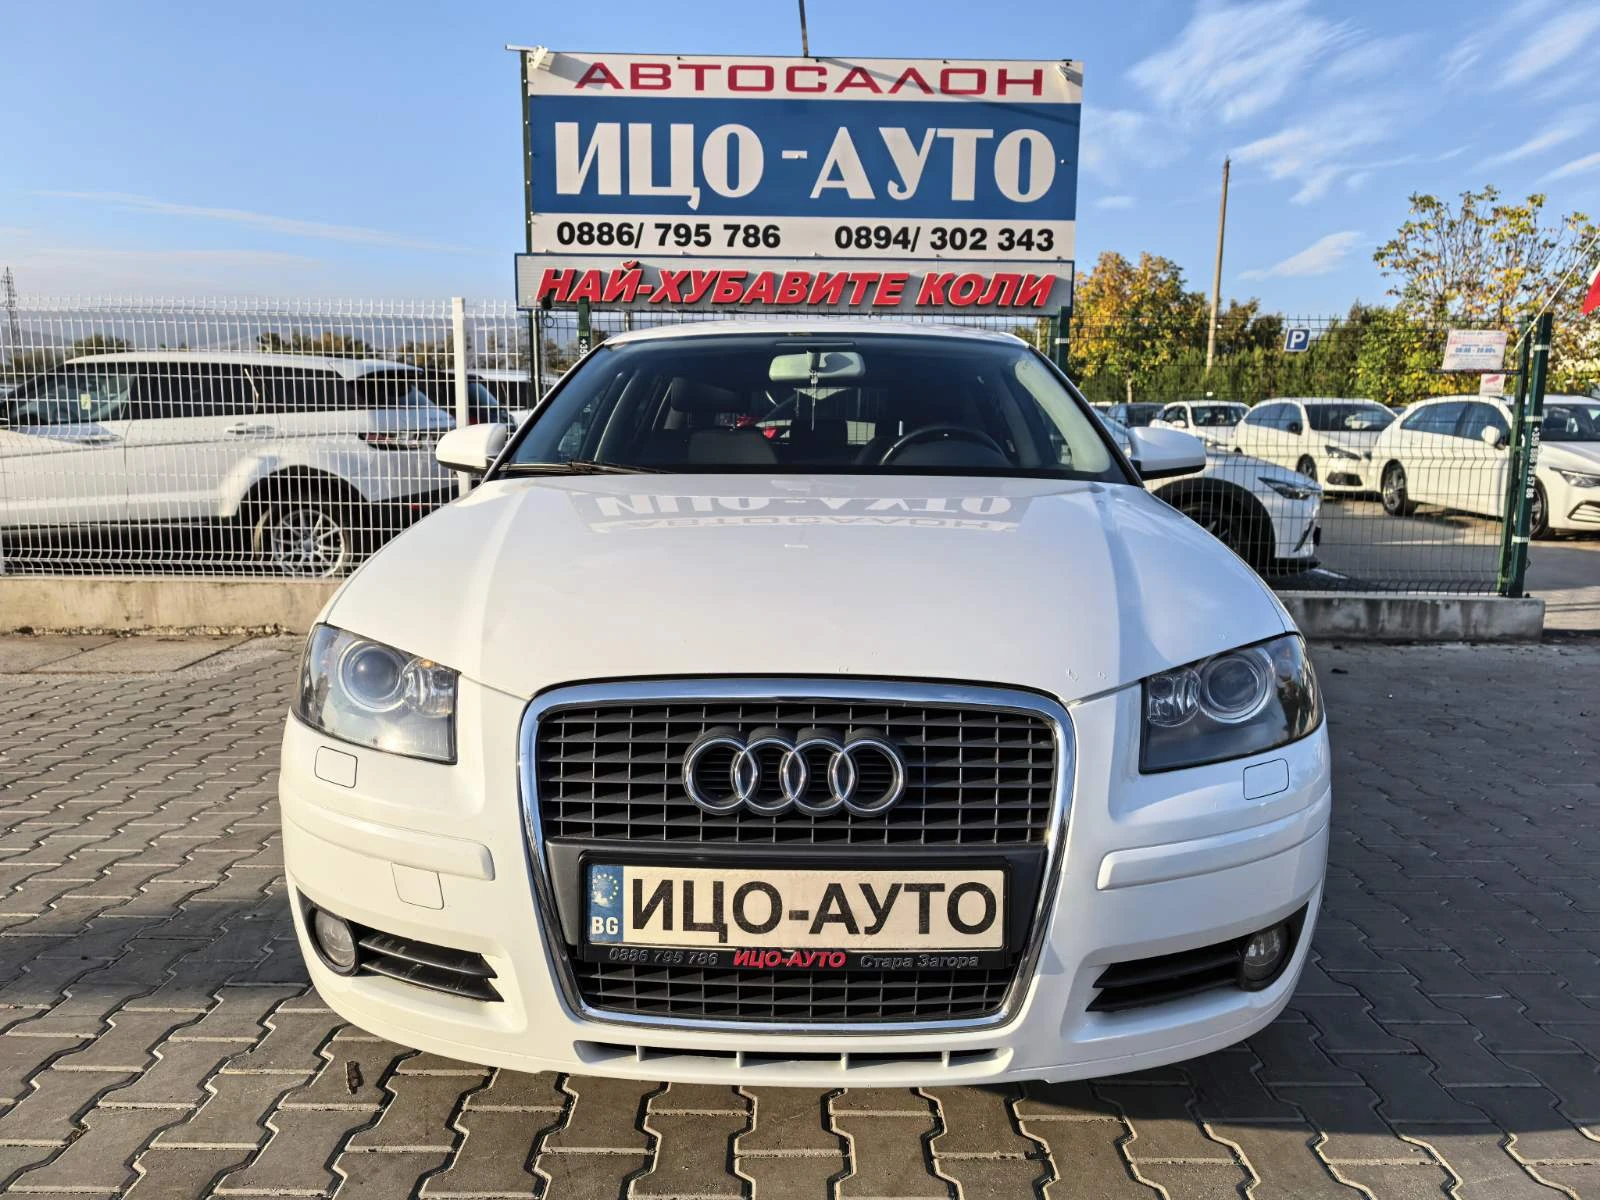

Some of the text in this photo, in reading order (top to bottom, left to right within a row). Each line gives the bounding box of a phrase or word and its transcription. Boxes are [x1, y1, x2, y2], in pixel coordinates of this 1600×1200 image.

[575, 62, 1044, 96] АВТОСАЛОН
[556, 221, 782, 249] 0886/ 795 786
[834, 225, 1055, 253] 0894/ 302 343
[536, 259, 1058, 308] НАЙ-ХУБАВИТЕ КОЛИ
[1290, 330, 1306, 348] P
[632, 878, 998, 943] ИЦО-АУТО
[591, 916, 619, 935] BG
[609, 947, 979, 970] 0886 795 786 ИЦО-АУТО Стара Загора
